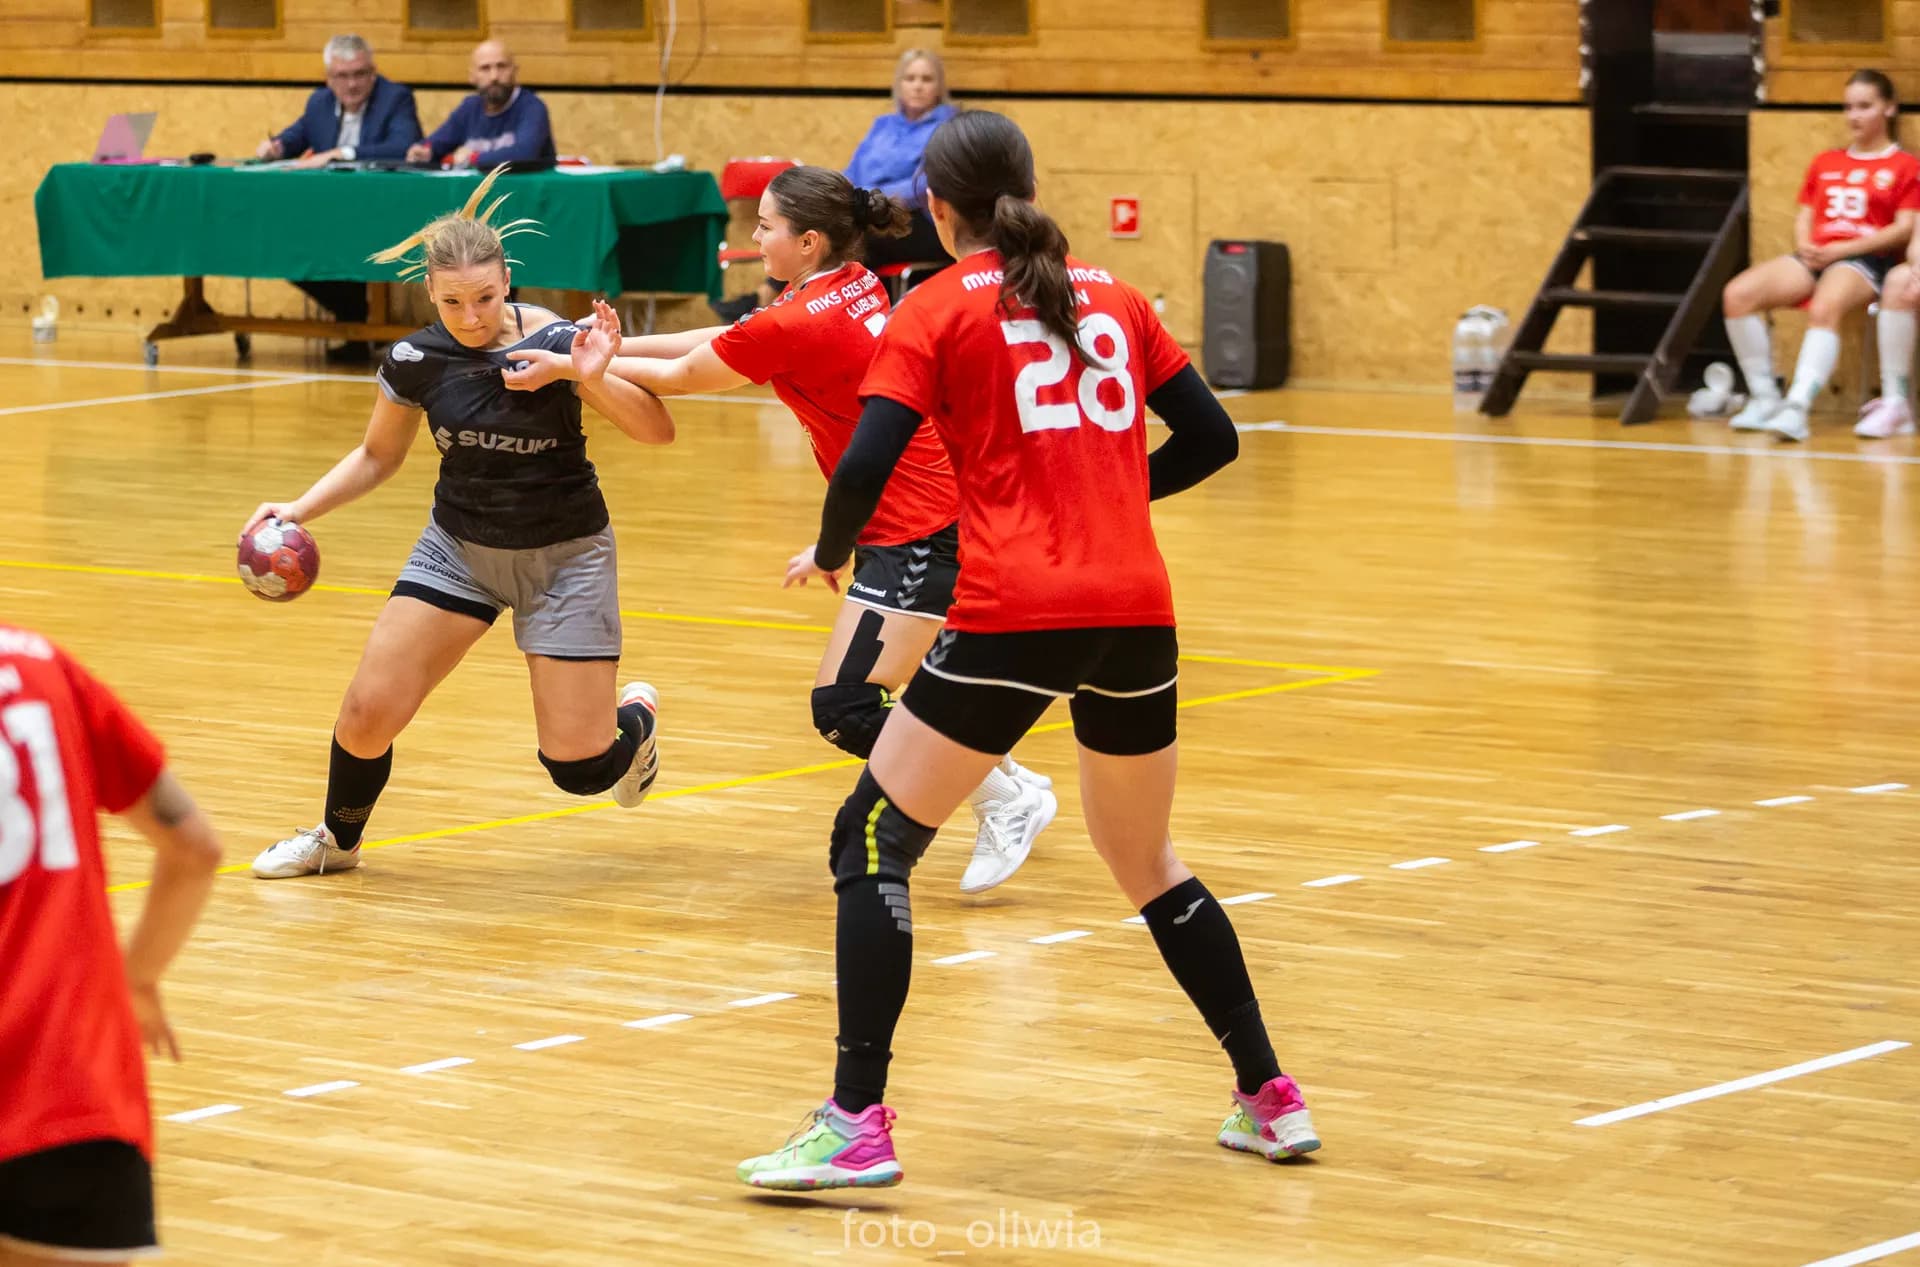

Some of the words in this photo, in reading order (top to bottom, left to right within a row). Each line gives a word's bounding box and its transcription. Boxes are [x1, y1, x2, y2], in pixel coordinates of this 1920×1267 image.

[961, 268, 1004, 291] MKS
[806, 291, 842, 315] MKS
[841, 280, 862, 300] AZS
[846, 293, 880, 319] LUBLIN
[1001, 313, 1136, 433] 28
[458, 430, 557, 454] SUZUKI
